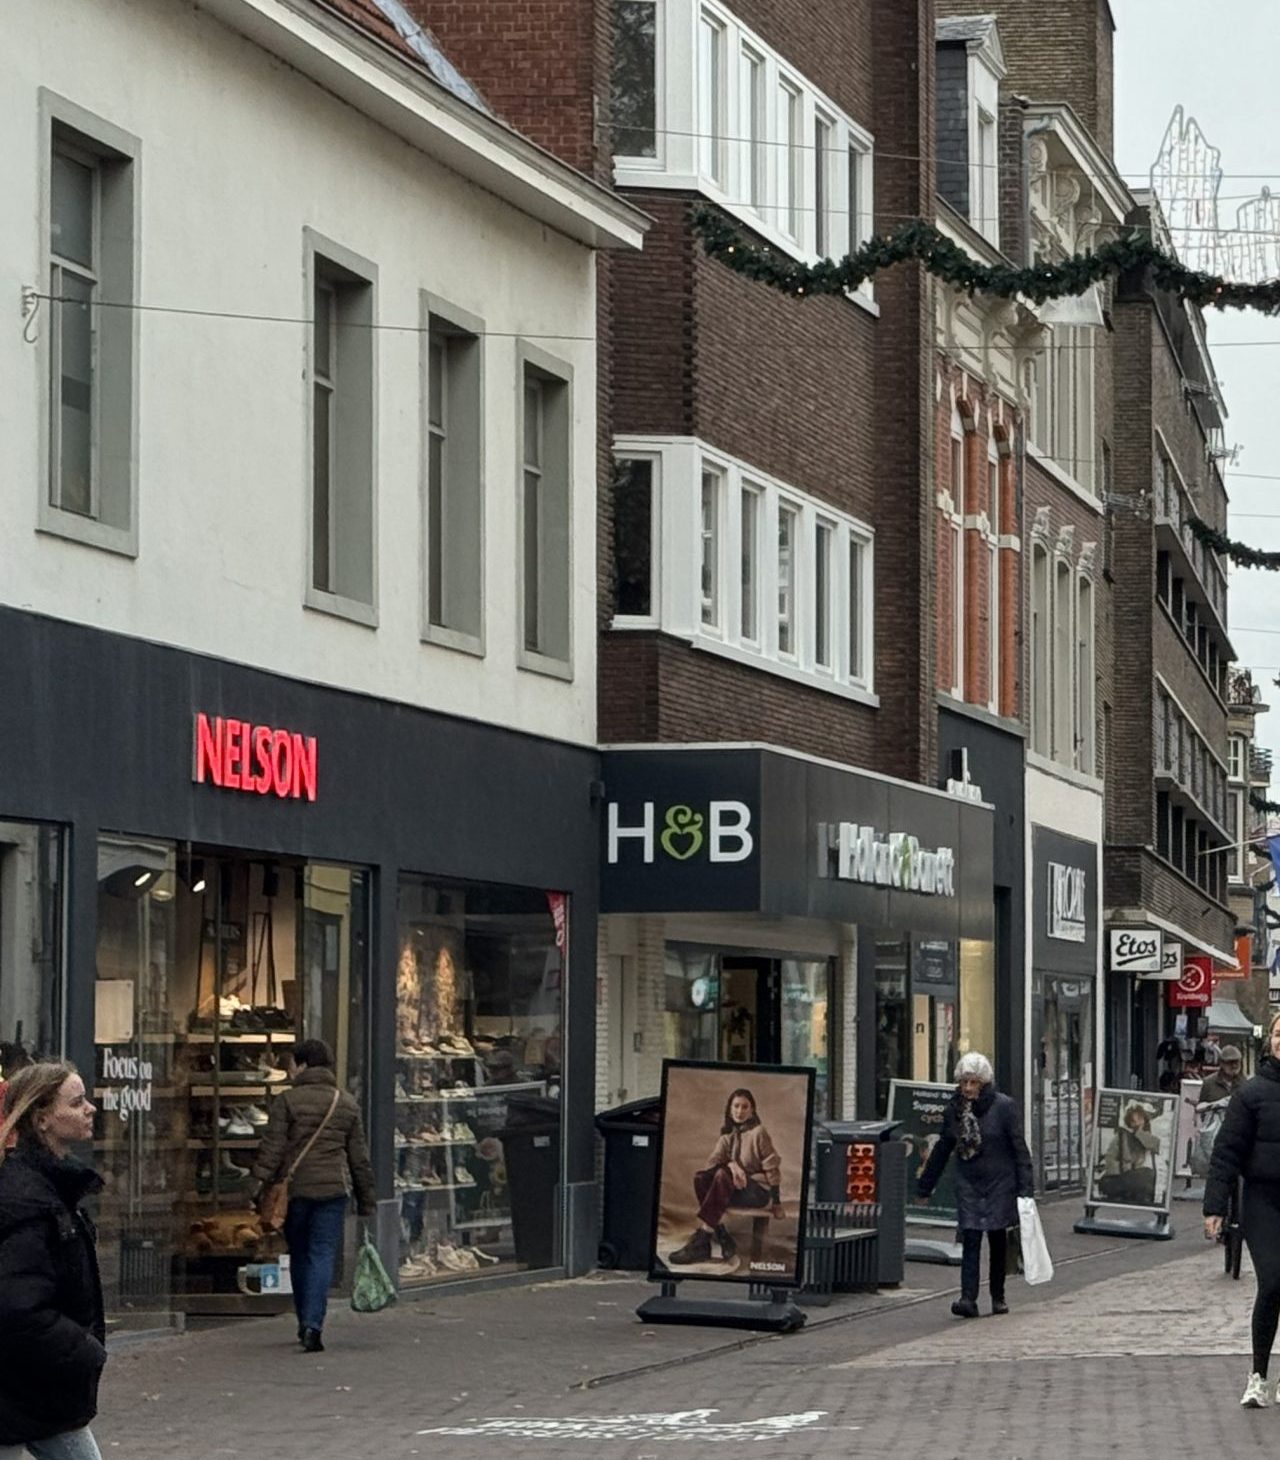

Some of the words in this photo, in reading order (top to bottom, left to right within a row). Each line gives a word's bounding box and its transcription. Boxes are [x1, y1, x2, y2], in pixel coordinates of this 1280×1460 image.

[194, 712, 317, 802] NELSON
[1115, 933, 1157, 957] Etos
[103, 1048, 138, 1079] Focus
[140, 1061, 153, 1080] on
[103, 1086, 119, 1111] the
[120, 1082, 153, 1121] good
[750, 1261, 786, 1272] NELSON
